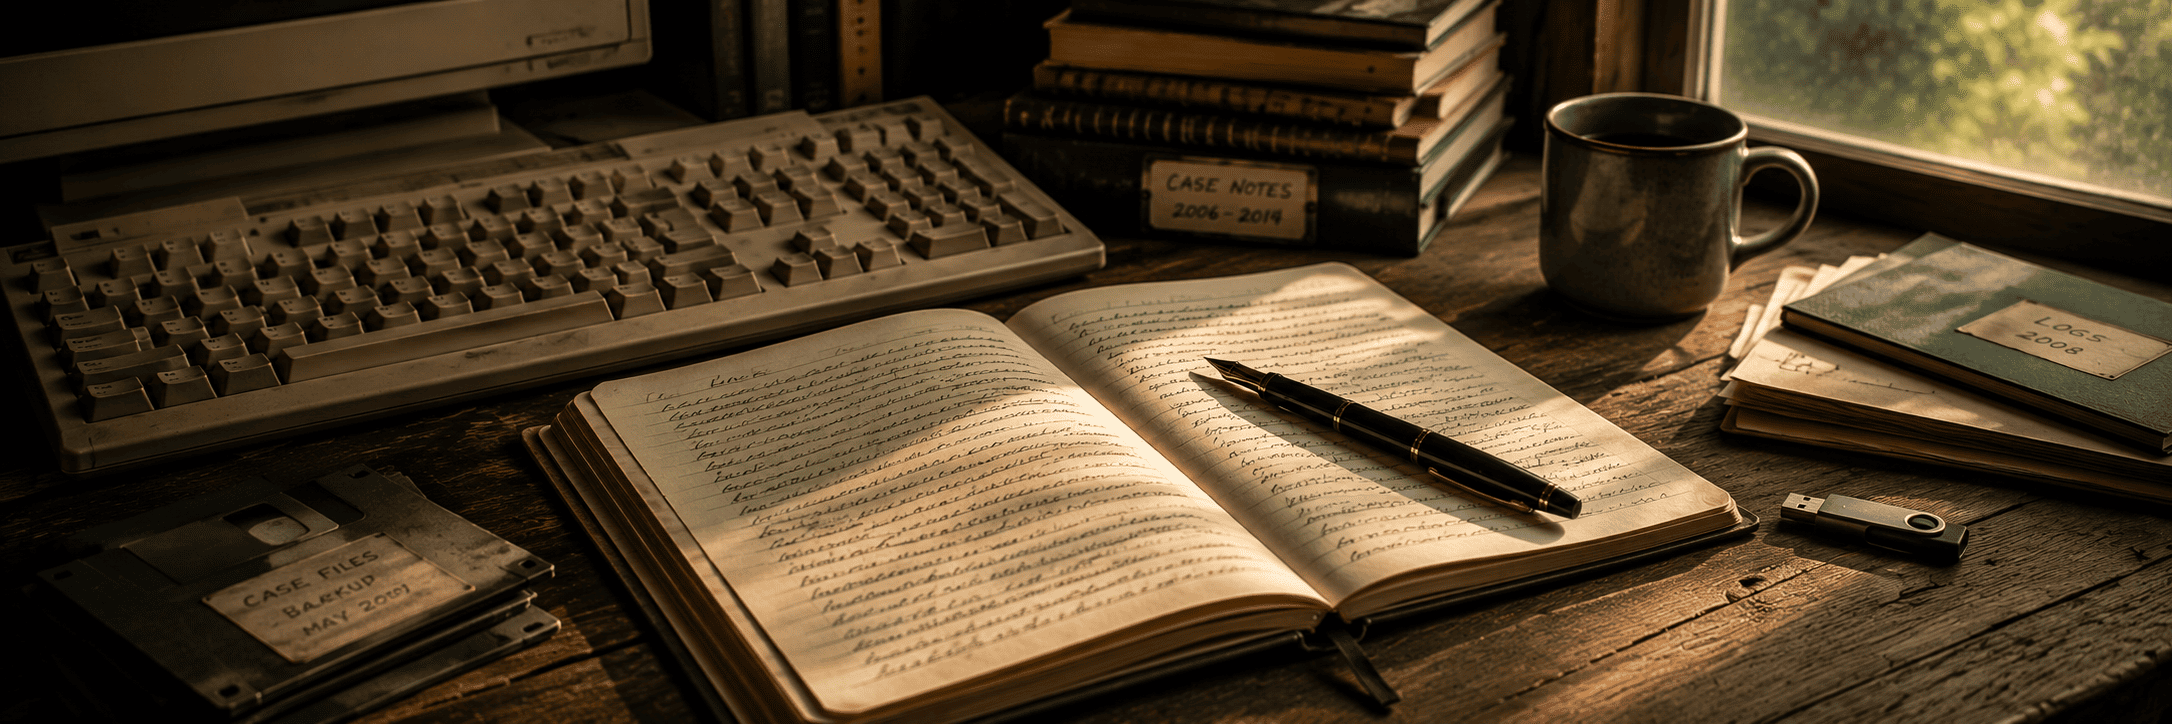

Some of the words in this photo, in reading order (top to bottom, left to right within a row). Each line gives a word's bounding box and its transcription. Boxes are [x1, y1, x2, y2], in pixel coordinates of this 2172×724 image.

[1165, 173, 1220, 193] CASE
[1229, 179, 1292, 199] NOTES
[2033, 316, 2112, 343] LOGS
[2015, 331, 2084, 355] 2008
[242, 577, 311, 608] CASE
[317, 550, 379, 580] FILES
[302, 610, 350, 636] MAY
